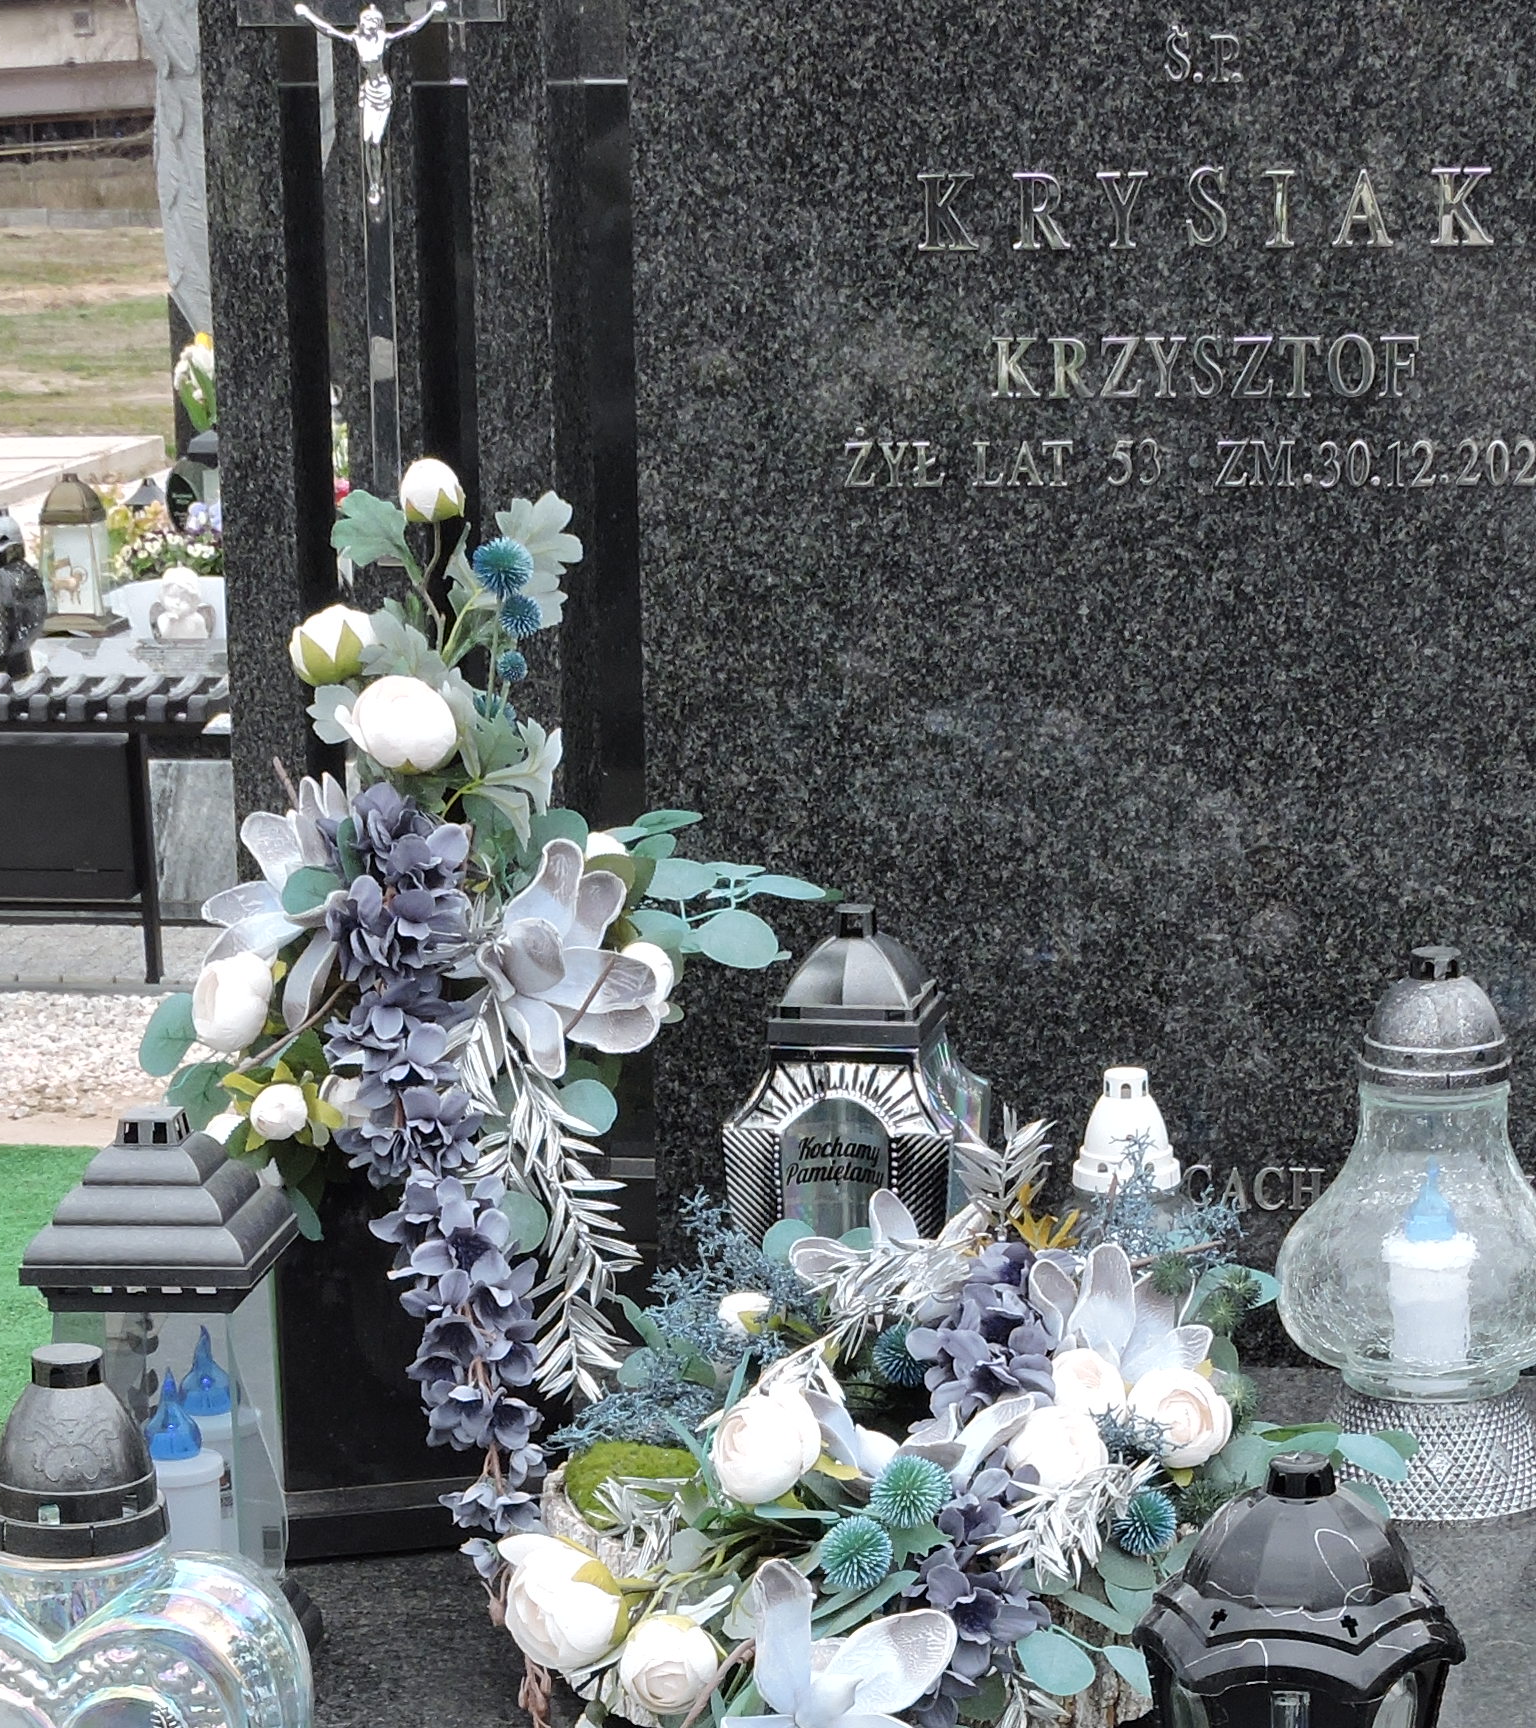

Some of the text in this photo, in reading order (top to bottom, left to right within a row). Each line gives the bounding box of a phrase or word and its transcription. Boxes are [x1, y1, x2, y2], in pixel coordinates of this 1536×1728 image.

[917, 166, 1494, 250] KRYSIAK
[990, 333, 1421, 400] KRZYSZTOF
[844, 427, 946, 488] ŻYŁ
[972, 440, 1073, 487] LAT
[1108, 437, 1162, 487] 53
[798, 1135, 880, 1169] Kochamy
